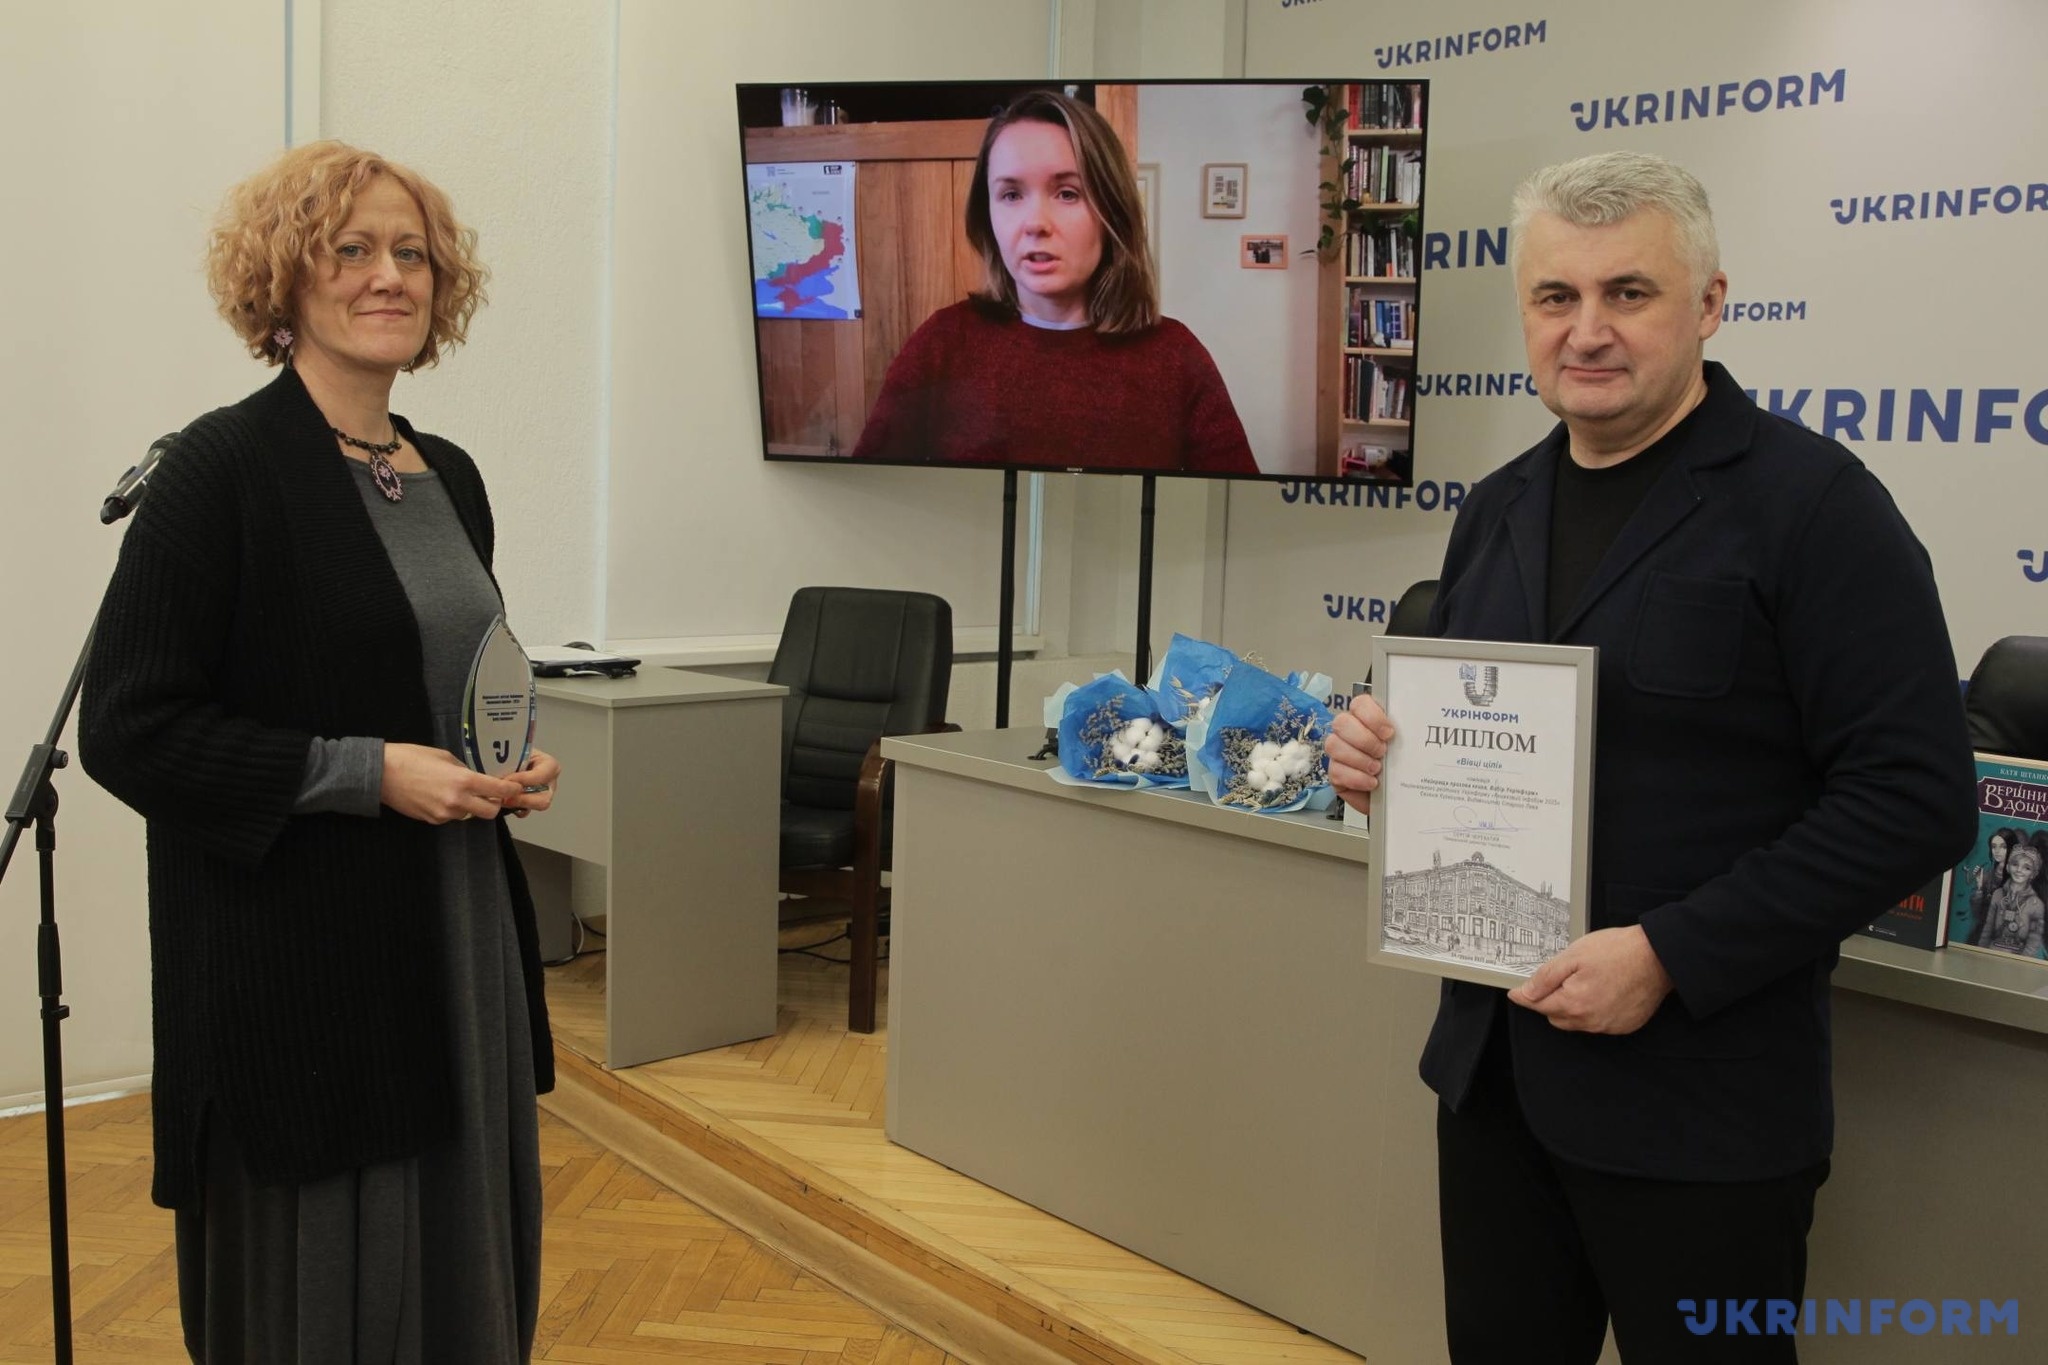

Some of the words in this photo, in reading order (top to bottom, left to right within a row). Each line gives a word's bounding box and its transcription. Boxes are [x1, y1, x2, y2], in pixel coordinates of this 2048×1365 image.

[1374, 19, 1547, 69] UKRINFORM
[1570, 68, 1846, 132] UKRINFORM
[1441, 707, 1519, 723] УКРІНФОРМ
[1425, 725, 1537, 754] ДИПЛОМ
